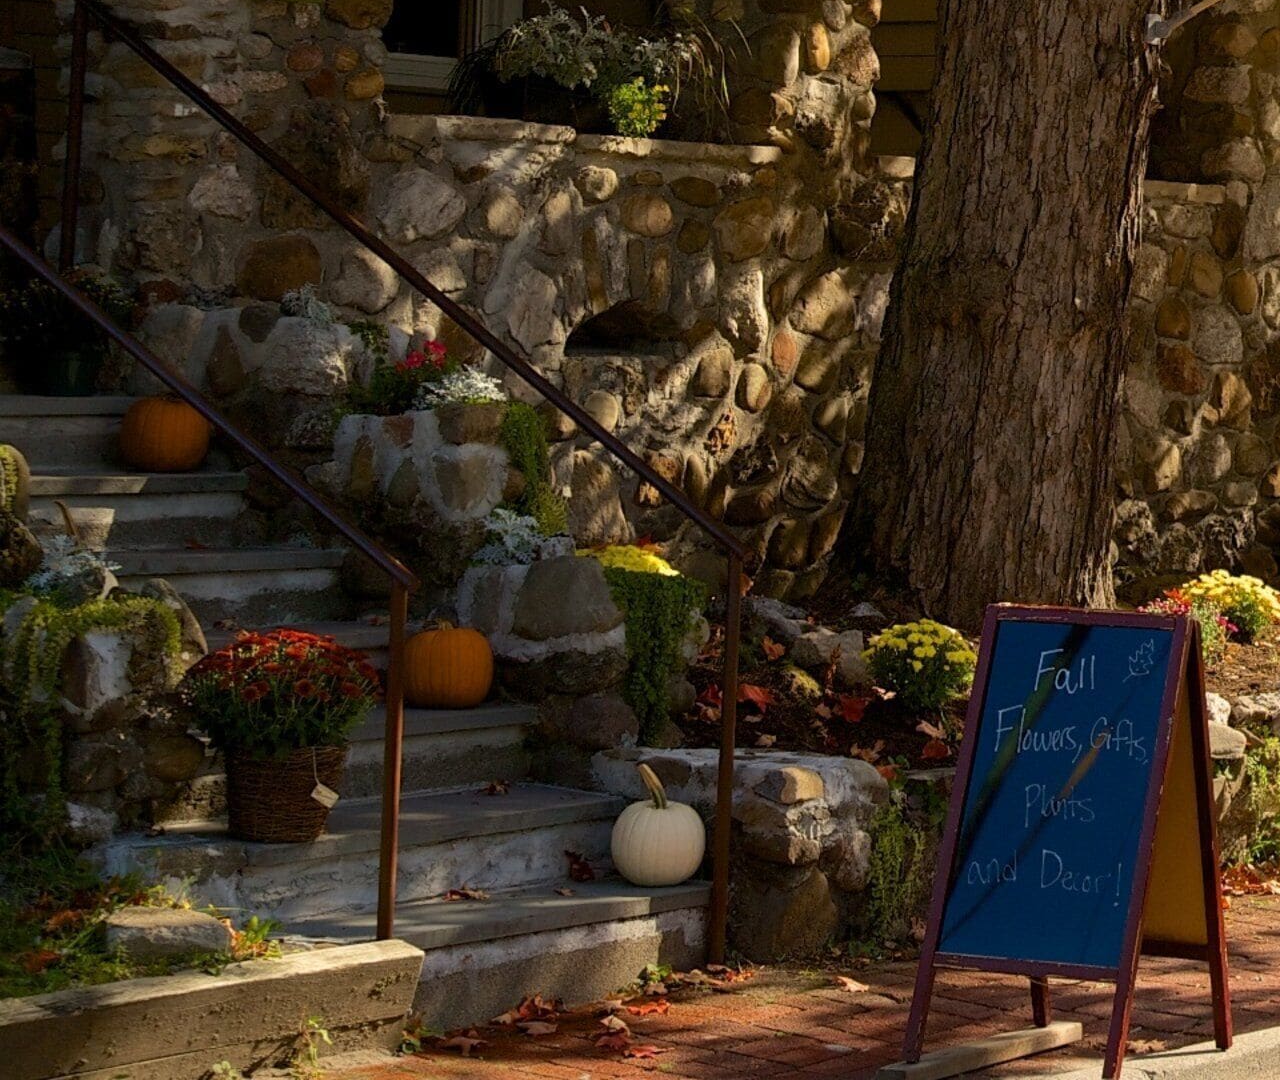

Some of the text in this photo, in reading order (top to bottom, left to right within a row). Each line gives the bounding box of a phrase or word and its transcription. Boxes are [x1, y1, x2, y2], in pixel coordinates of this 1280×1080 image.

[1034, 648, 1095, 694] Fall
[994, 704, 1148, 765] Flowers, Gifts,
[1024, 783, 1096, 828] Plants
[967, 850, 1017, 885] and
